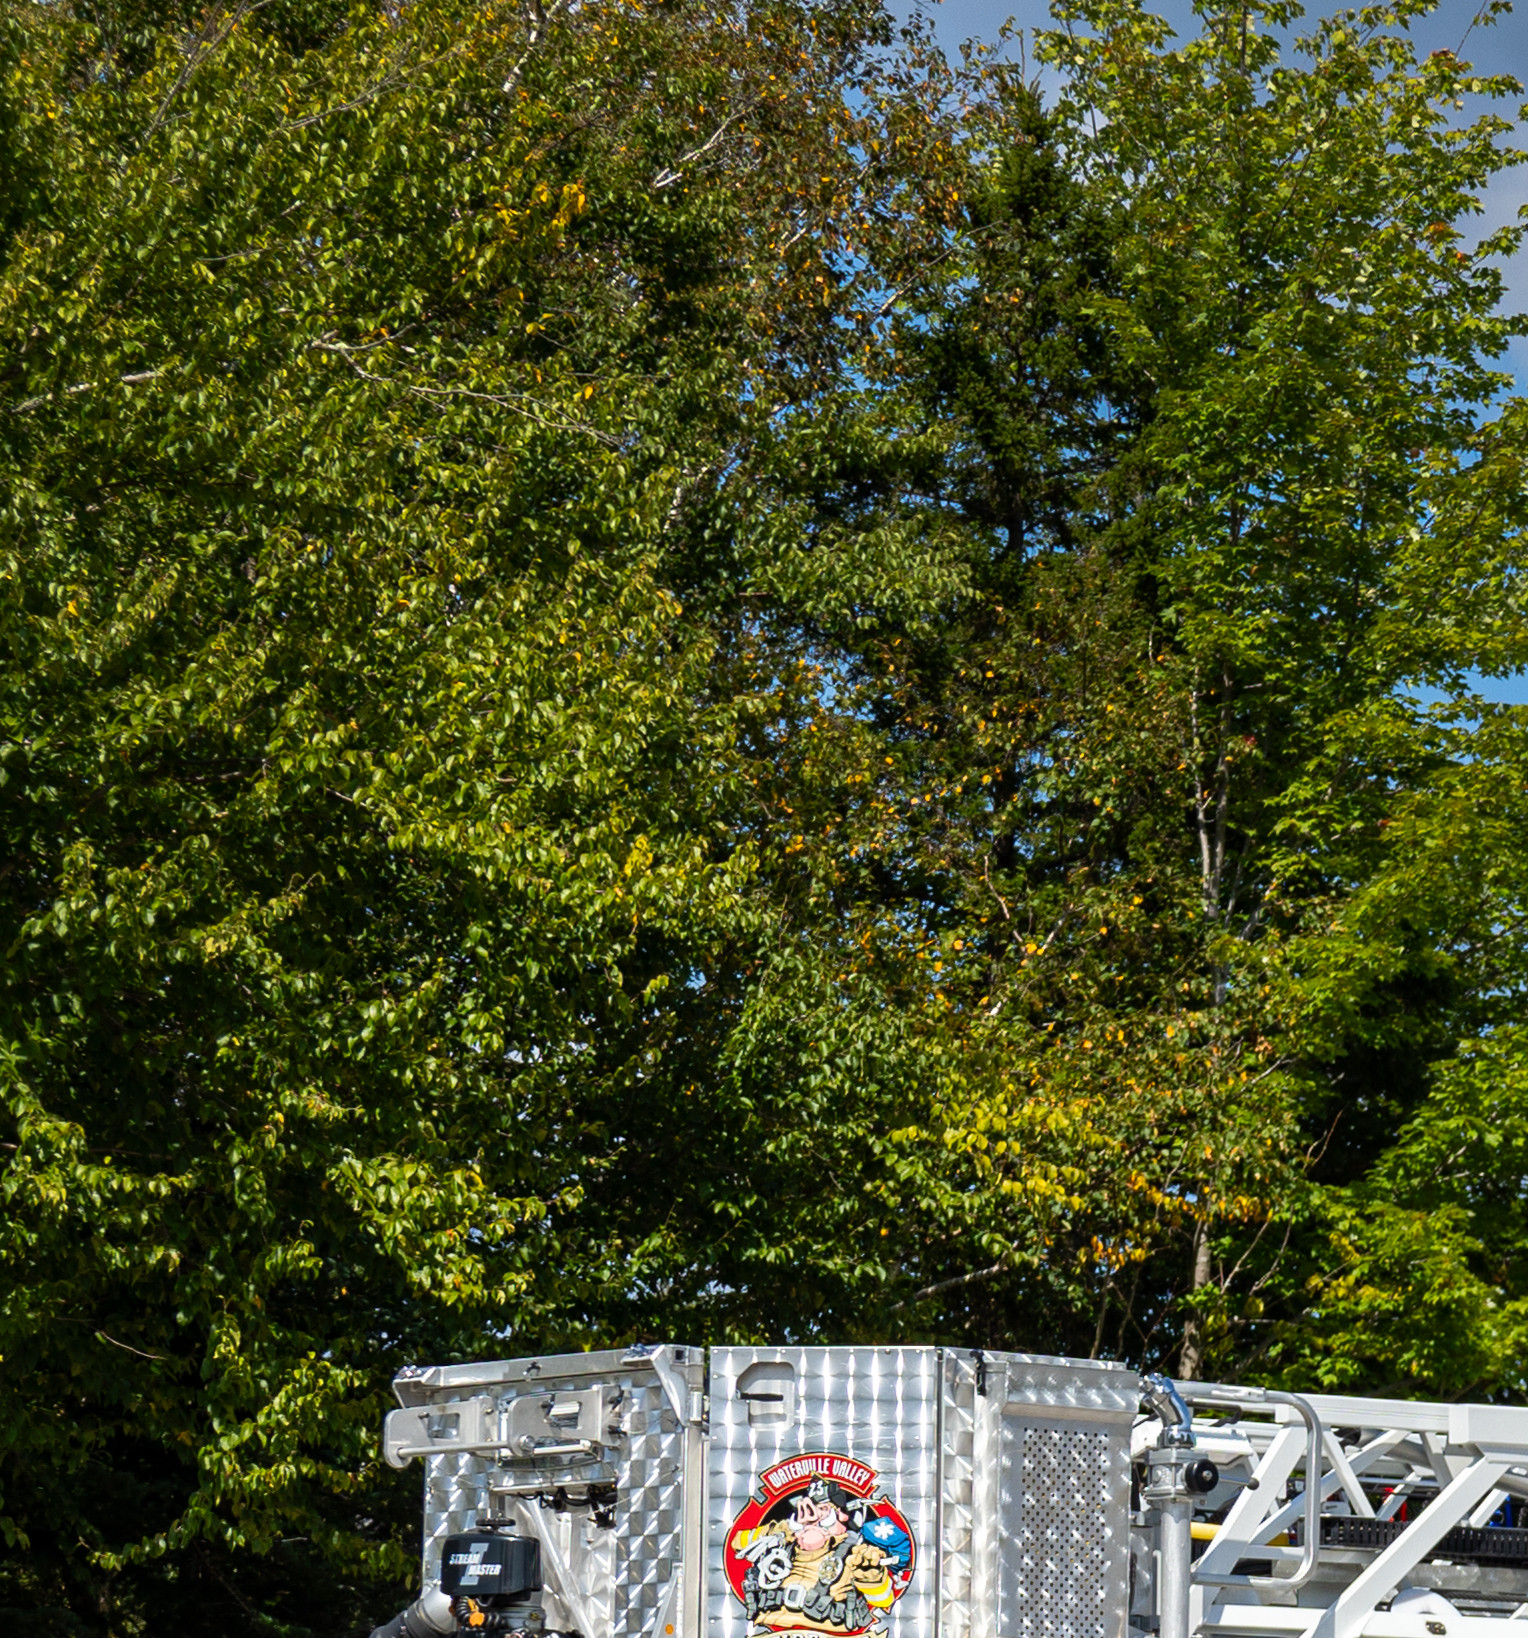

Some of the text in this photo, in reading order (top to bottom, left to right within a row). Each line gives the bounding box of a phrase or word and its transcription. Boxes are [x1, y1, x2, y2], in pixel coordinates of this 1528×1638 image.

[832, 1459, 871, 1486] VALLEY
[809, 1481, 824, 1498] 23
[449, 1553, 481, 1565] STREAM
[468, 1564, 502, 1576] MASTER
